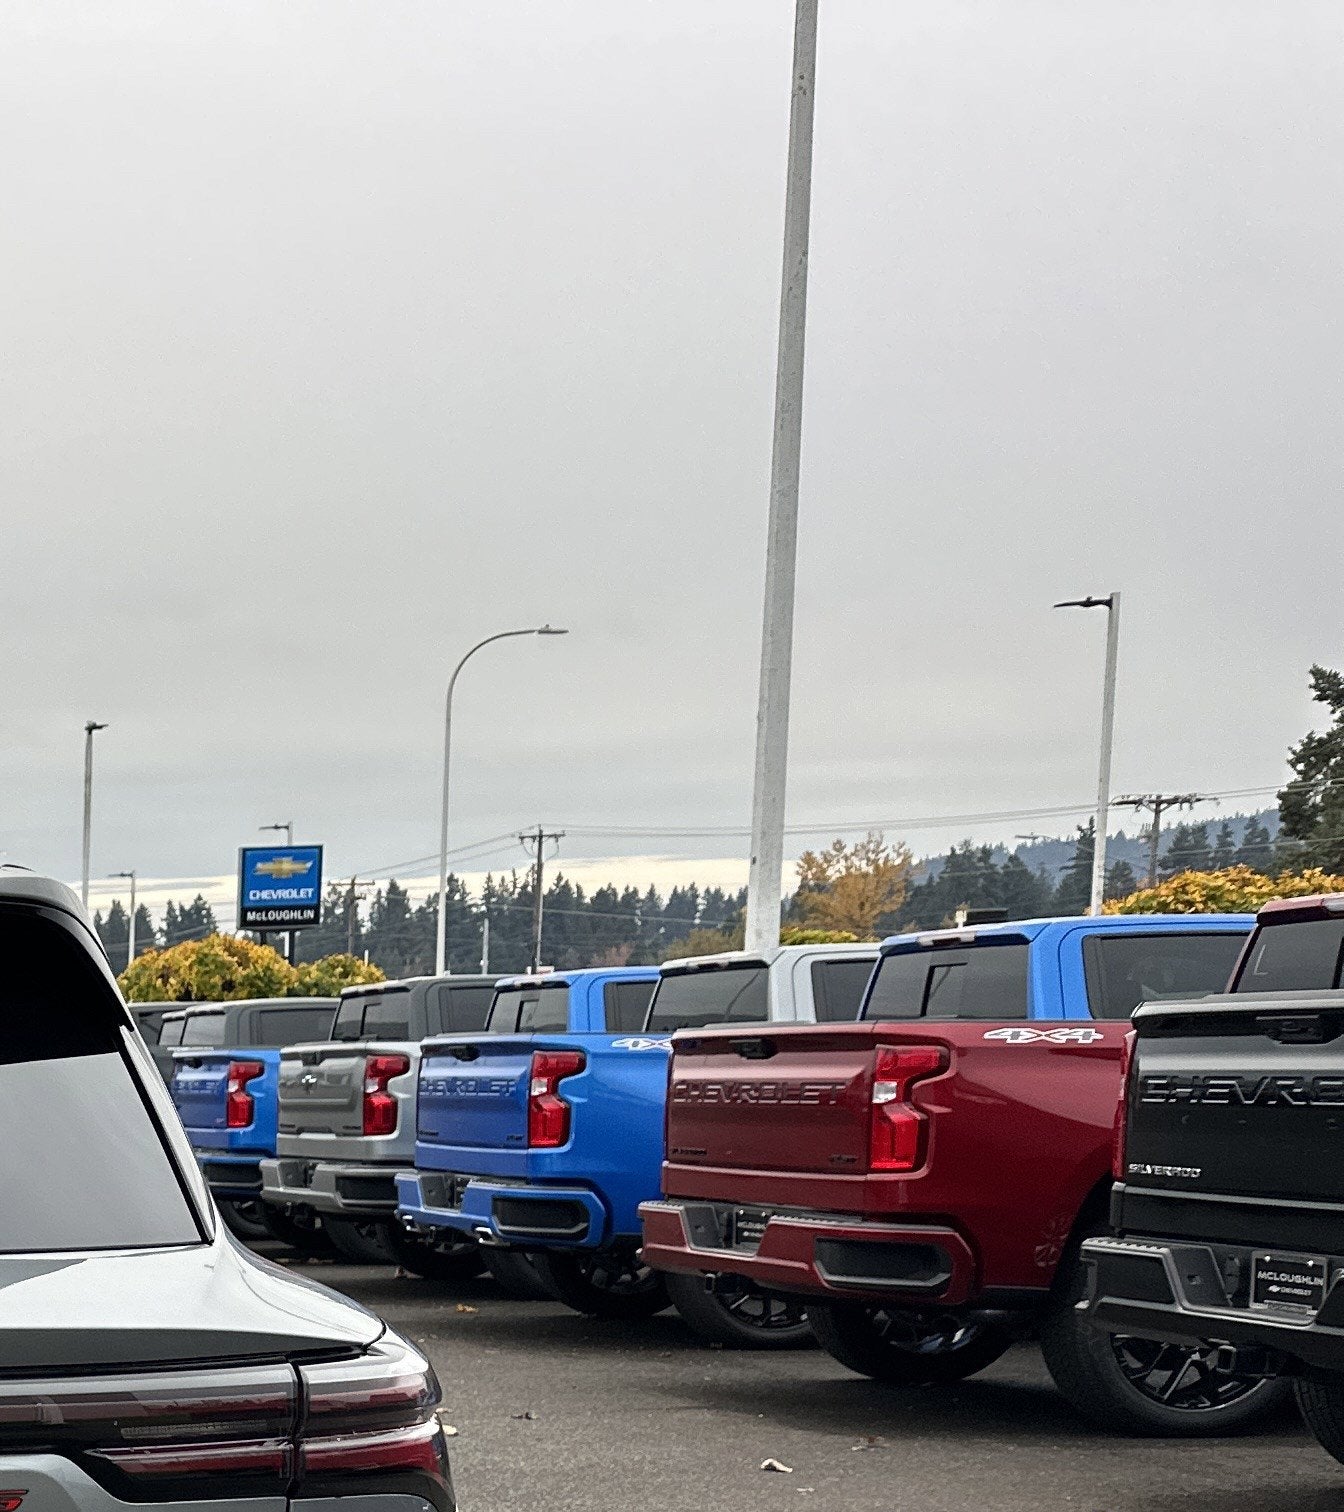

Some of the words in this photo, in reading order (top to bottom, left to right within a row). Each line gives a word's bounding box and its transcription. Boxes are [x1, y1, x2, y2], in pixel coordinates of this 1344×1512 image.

[249, 888, 314, 901] CHEVROLET
[246, 909, 315, 921] McLOUGHLIN
[673, 1081, 847, 1105] CHEVROLET
[1128, 1163, 1202, 1178] SILVERADO
[1257, 1270, 1324, 1286] MCLOUGHLIN
